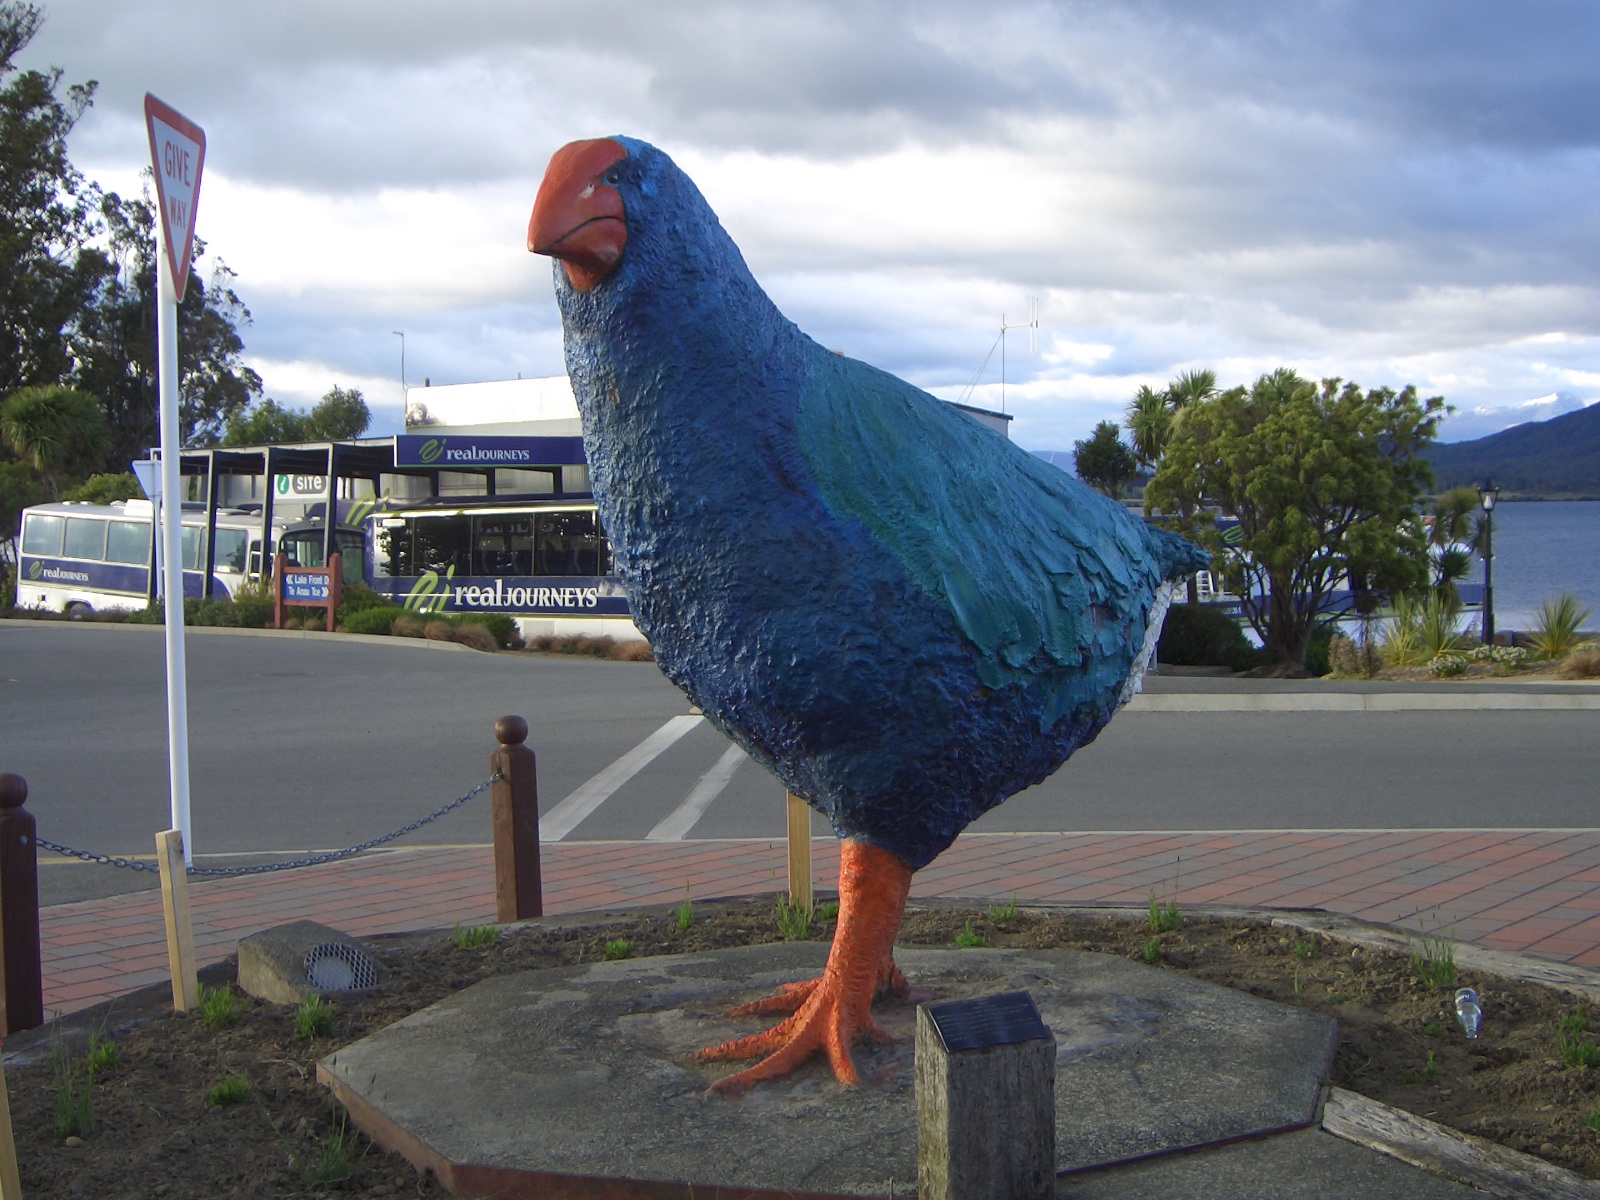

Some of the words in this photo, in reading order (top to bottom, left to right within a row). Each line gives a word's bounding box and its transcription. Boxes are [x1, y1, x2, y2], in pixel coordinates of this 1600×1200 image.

[165, 140, 190, 187] GIVE
[169, 195, 187, 230] WAY
[295, 575, 308, 584] Lake
[308, 575, 323, 585] Front
[289, 587, 295, 596] Te
[296, 587, 310, 596] Anau
[311, 587, 321, 597] Tce
